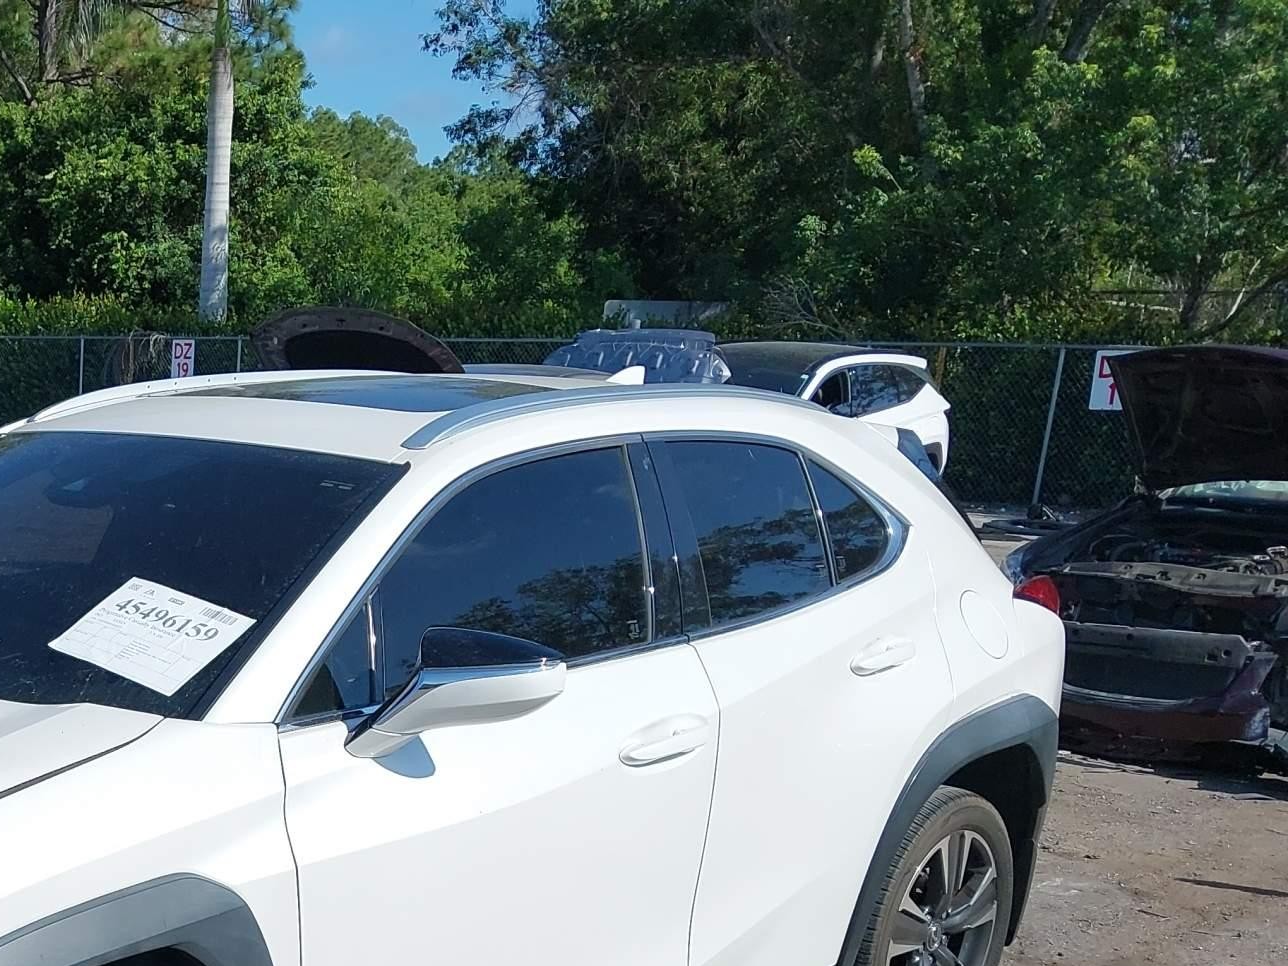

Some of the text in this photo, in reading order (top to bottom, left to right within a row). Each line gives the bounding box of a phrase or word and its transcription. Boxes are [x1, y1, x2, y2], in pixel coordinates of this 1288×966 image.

[174, 343, 192, 359] DZ
[177, 362, 189, 377] 19
[115, 599, 219, 641] 45496159
